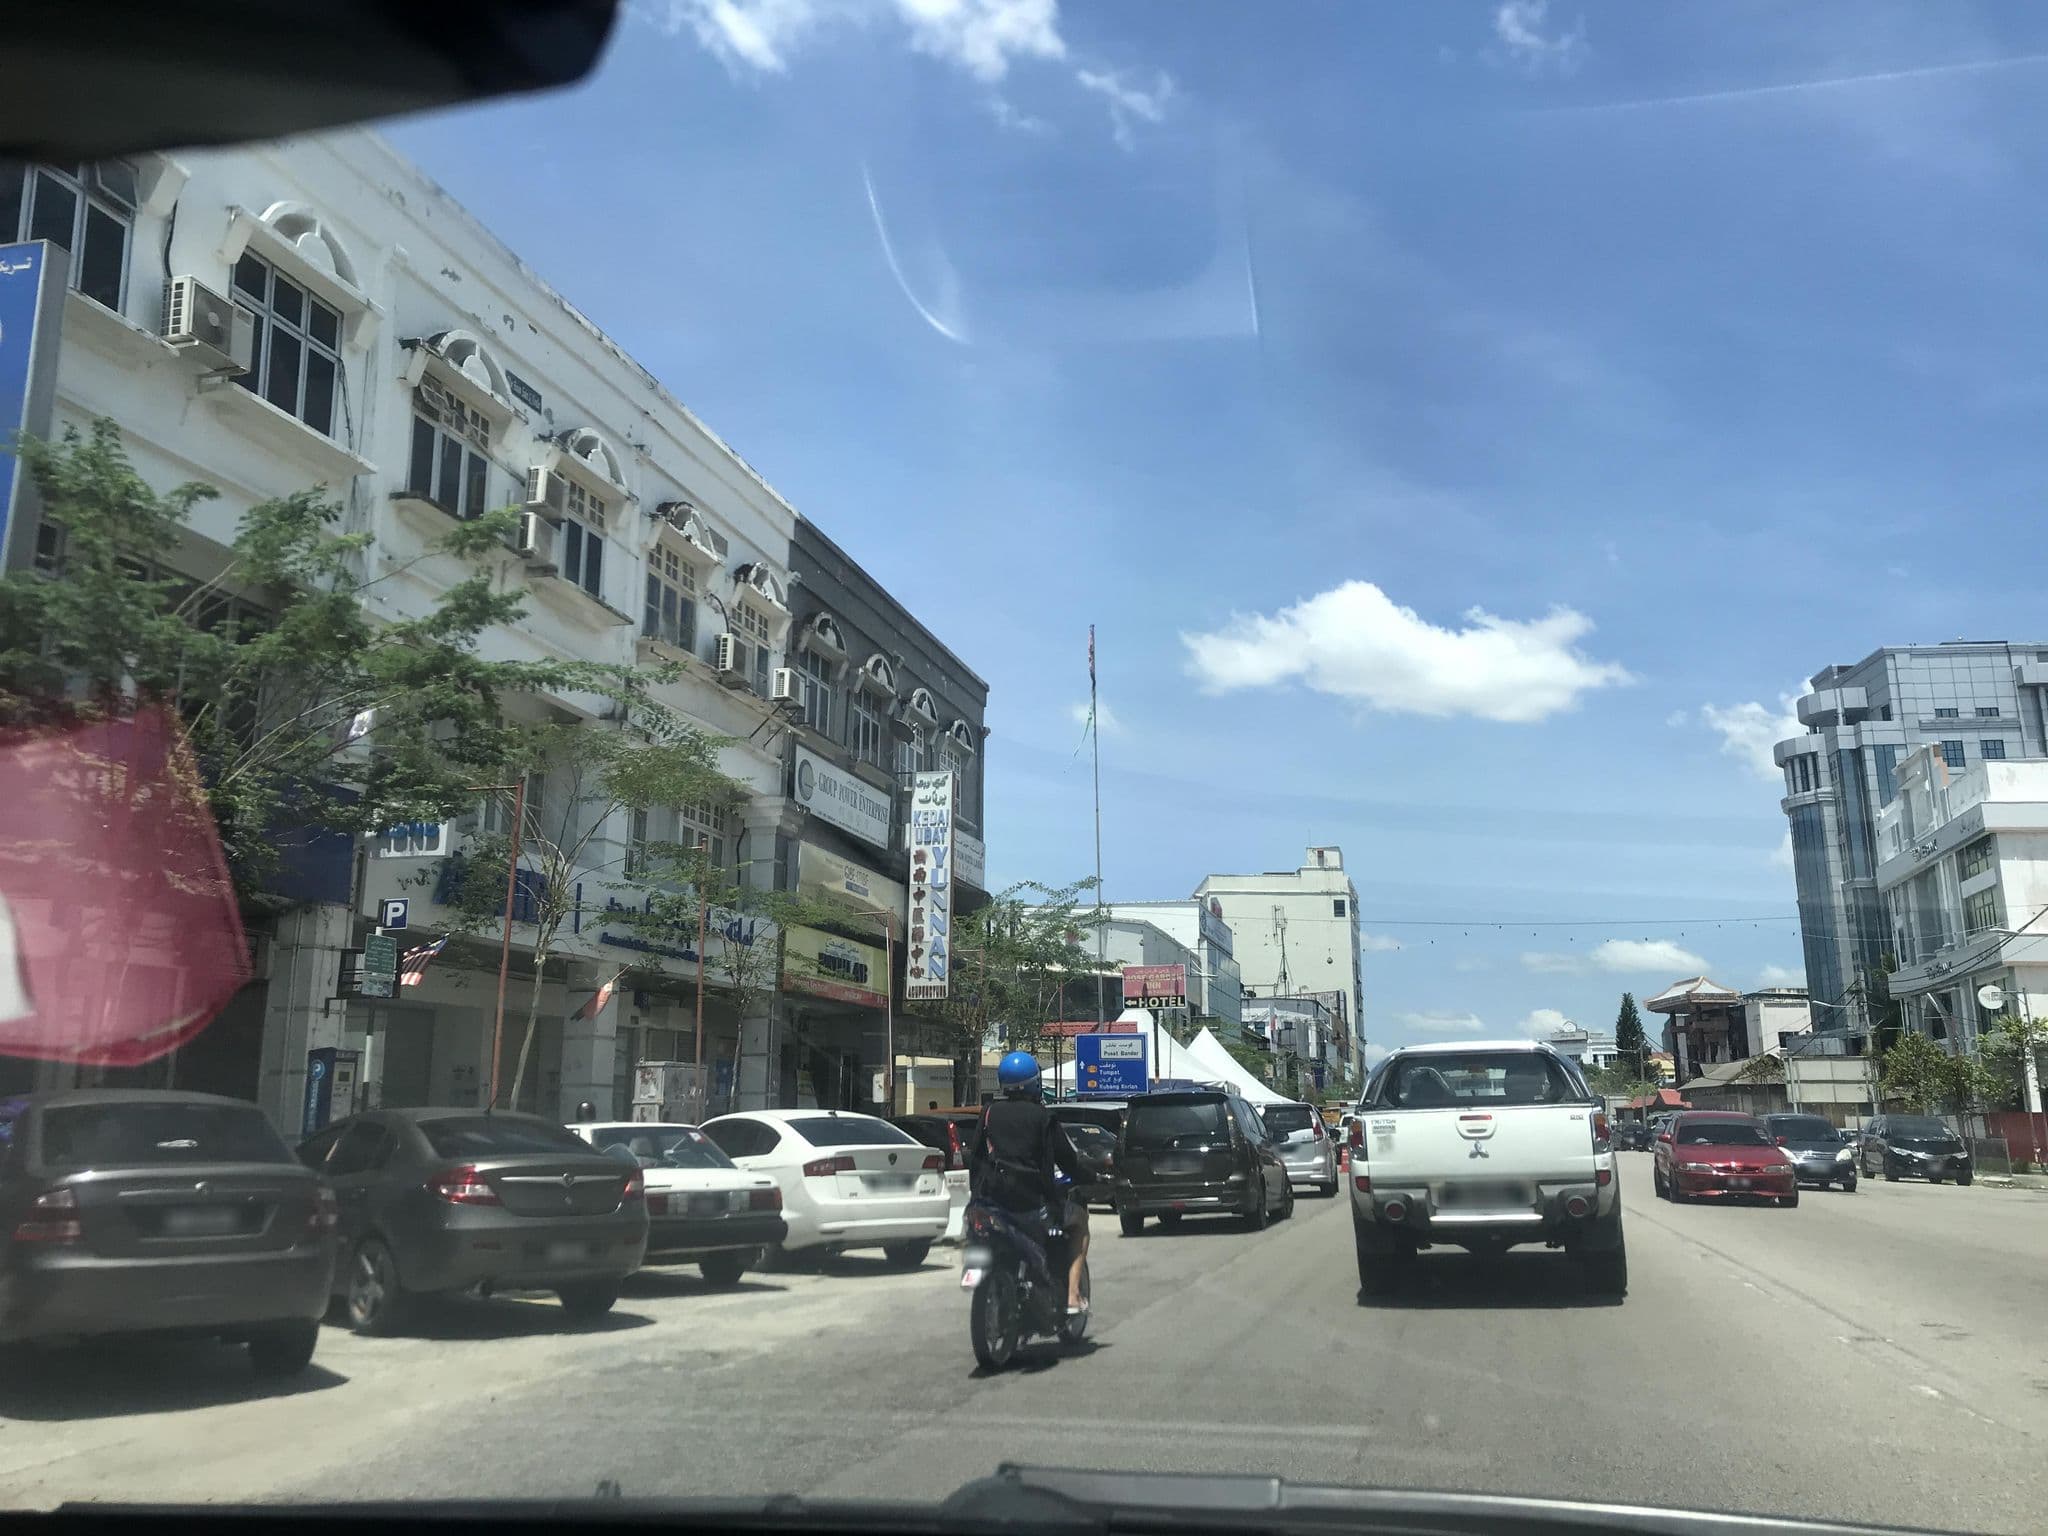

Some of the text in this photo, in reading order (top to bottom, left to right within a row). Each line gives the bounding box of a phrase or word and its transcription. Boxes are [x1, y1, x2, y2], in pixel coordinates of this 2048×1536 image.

[858, 793, 889, 825] ENTERPRISE
[913, 809, 950, 827] KEDAI
[915, 827, 947, 845] UBAT
[386, 902, 405, 927] P
[929, 846, 948, 982] YUNNAN
[1139, 997, 1184, 1008] HOTEL
